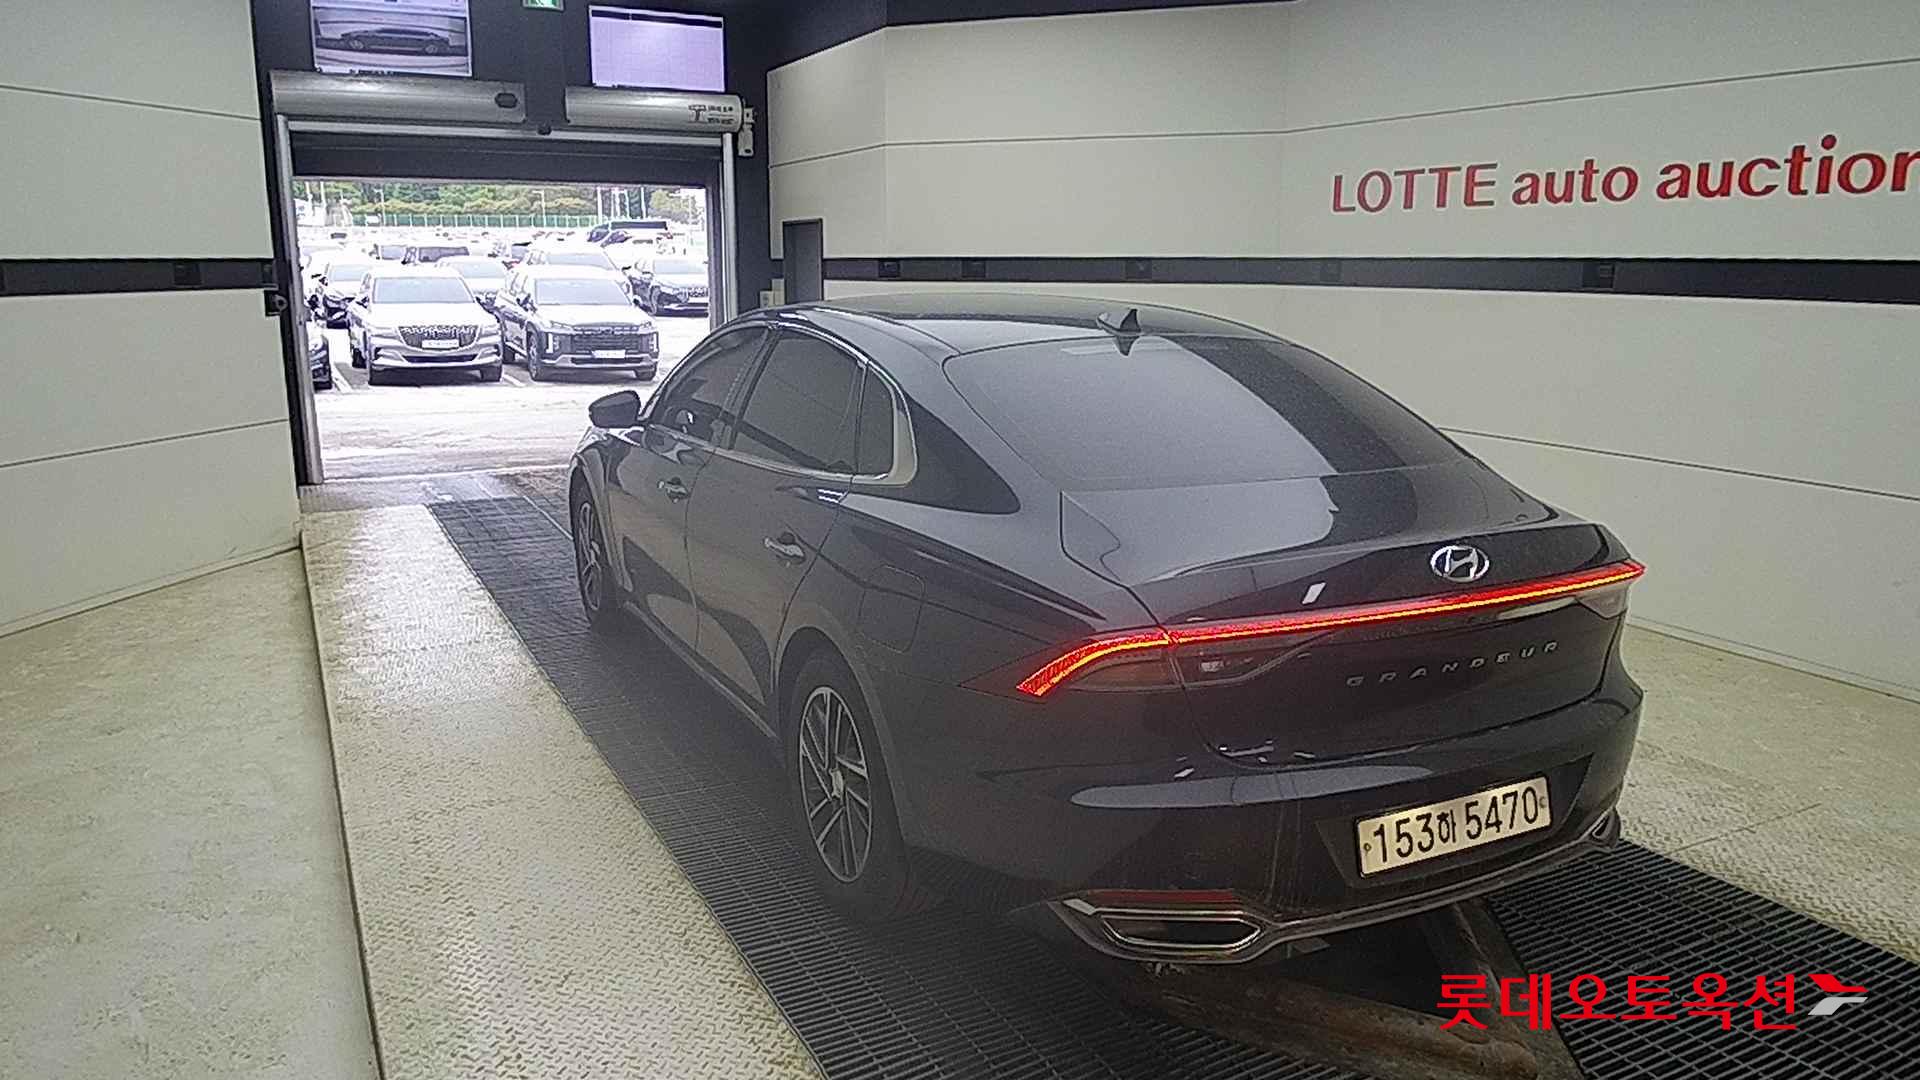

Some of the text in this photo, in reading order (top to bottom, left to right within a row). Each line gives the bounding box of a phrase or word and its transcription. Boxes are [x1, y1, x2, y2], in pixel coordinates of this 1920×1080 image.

[1332, 163, 1499, 213] LOTTE
[1512, 159, 1638, 205] auto
[1346, 641, 1558, 687] GRANDEUR
